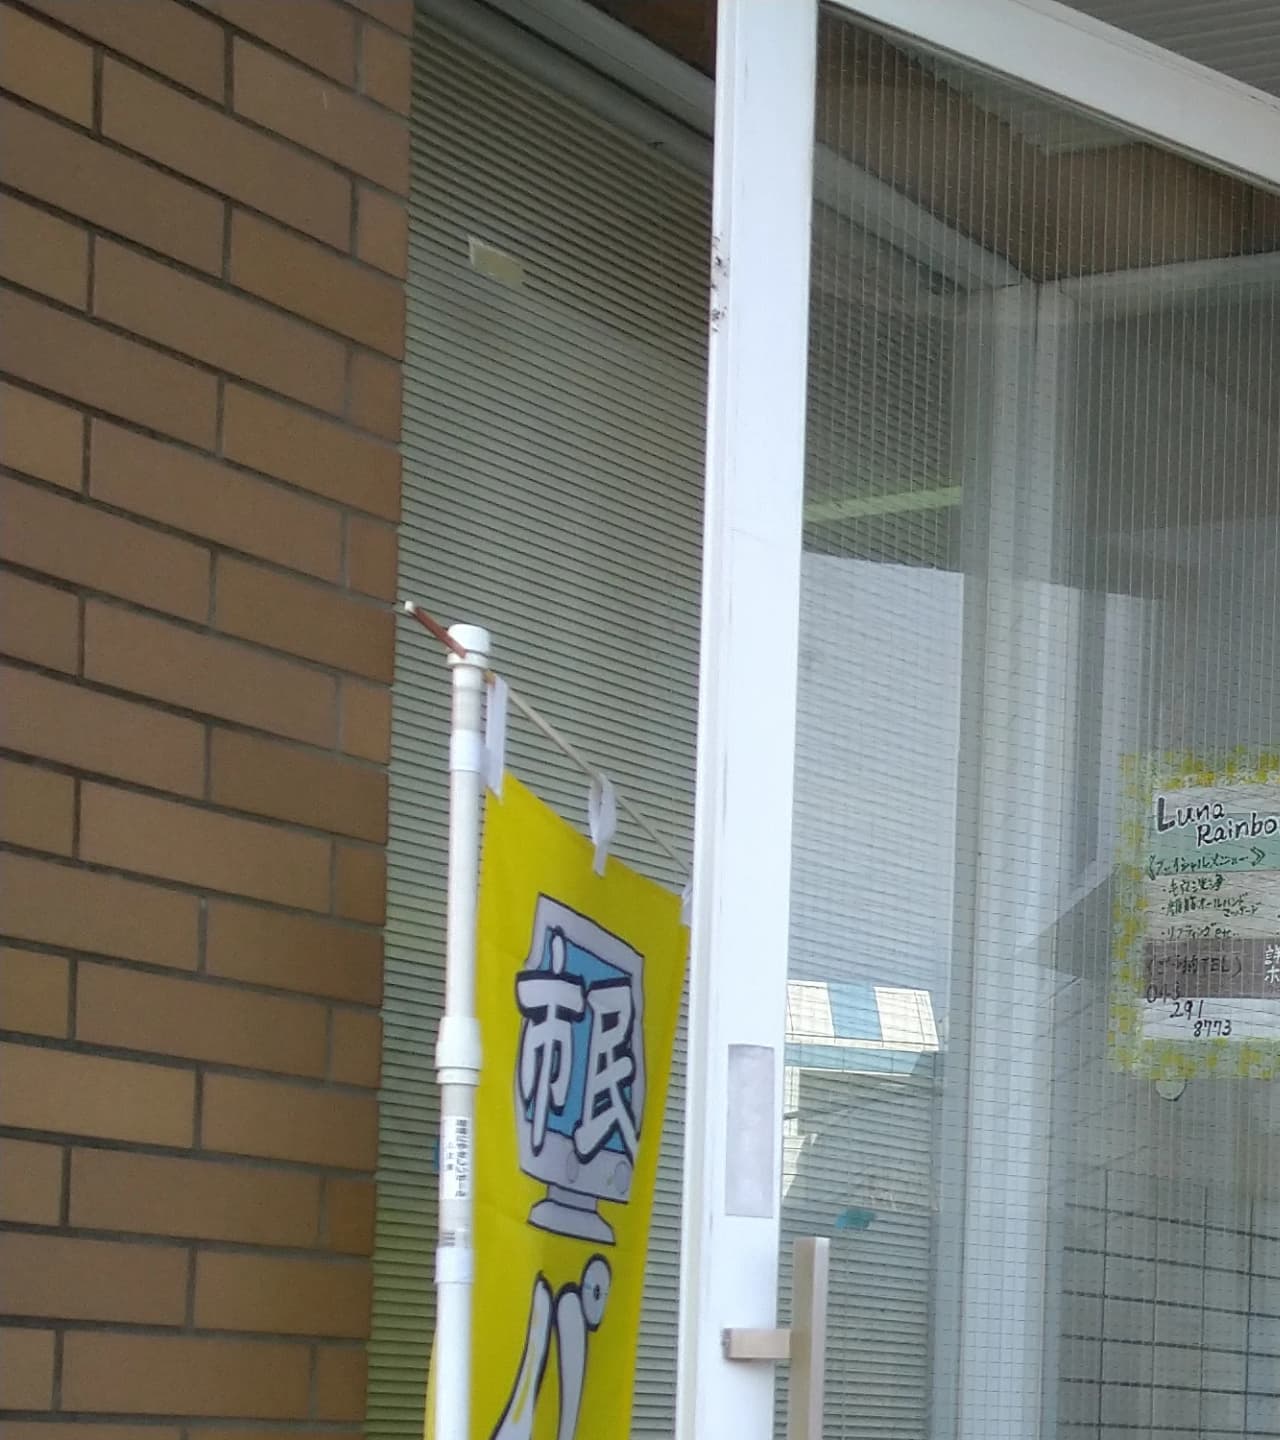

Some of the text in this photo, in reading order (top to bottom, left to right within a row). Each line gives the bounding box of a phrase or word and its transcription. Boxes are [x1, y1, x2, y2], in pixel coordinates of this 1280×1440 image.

[1156, 797, 1226, 833] Luna
[1169, 1000, 1204, 1020] 291
[1194, 1019, 1232, 1037] 8773
[514, 925, 641, 1162] 市民
